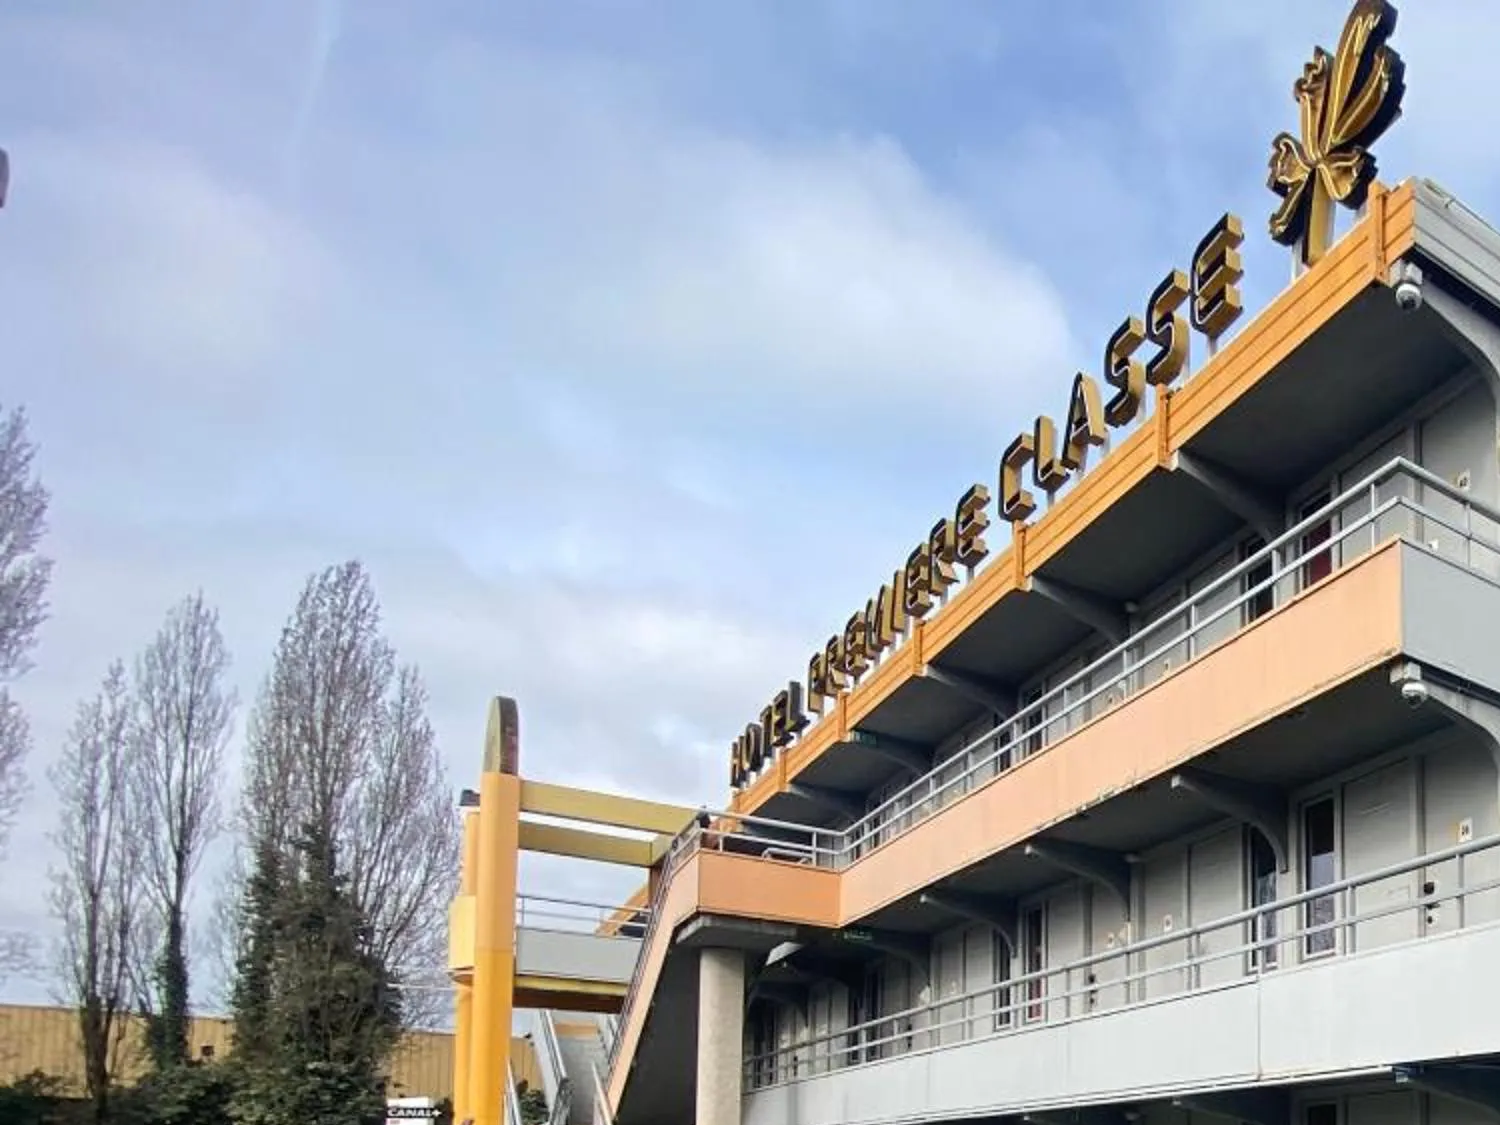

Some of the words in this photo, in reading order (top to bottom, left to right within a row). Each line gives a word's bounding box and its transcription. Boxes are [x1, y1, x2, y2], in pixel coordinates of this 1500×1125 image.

[731, 681, 810, 788] HOTEL
[808, 484, 990, 713] PREMIERE
[998, 212, 1245, 522] CLASSE
[387, 1108, 442, 1118] CANAL+
